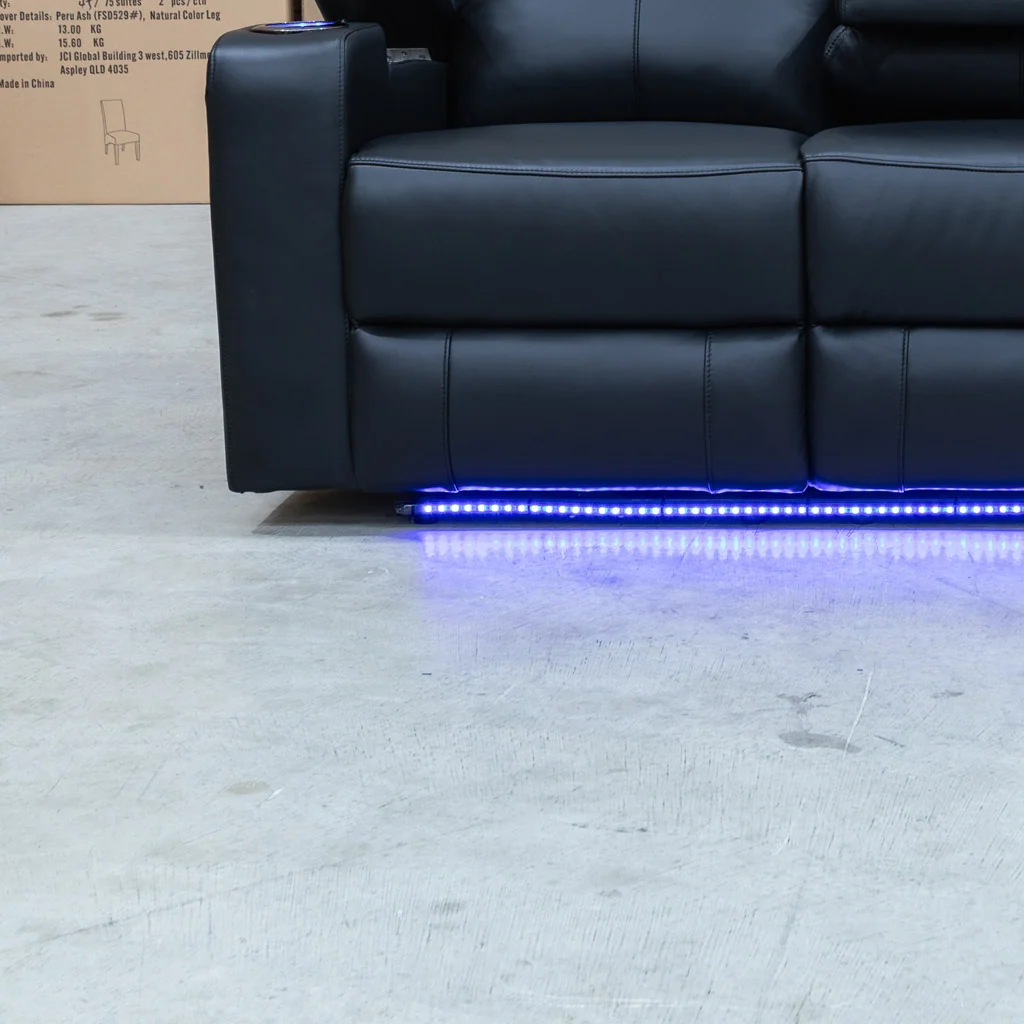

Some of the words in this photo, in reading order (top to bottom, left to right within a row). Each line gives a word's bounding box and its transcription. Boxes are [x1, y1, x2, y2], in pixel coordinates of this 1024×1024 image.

[60, 65, 87, 76] Aspley
[90, 65, 105, 74] QLD
[108, 64, 128, 74] 4035
